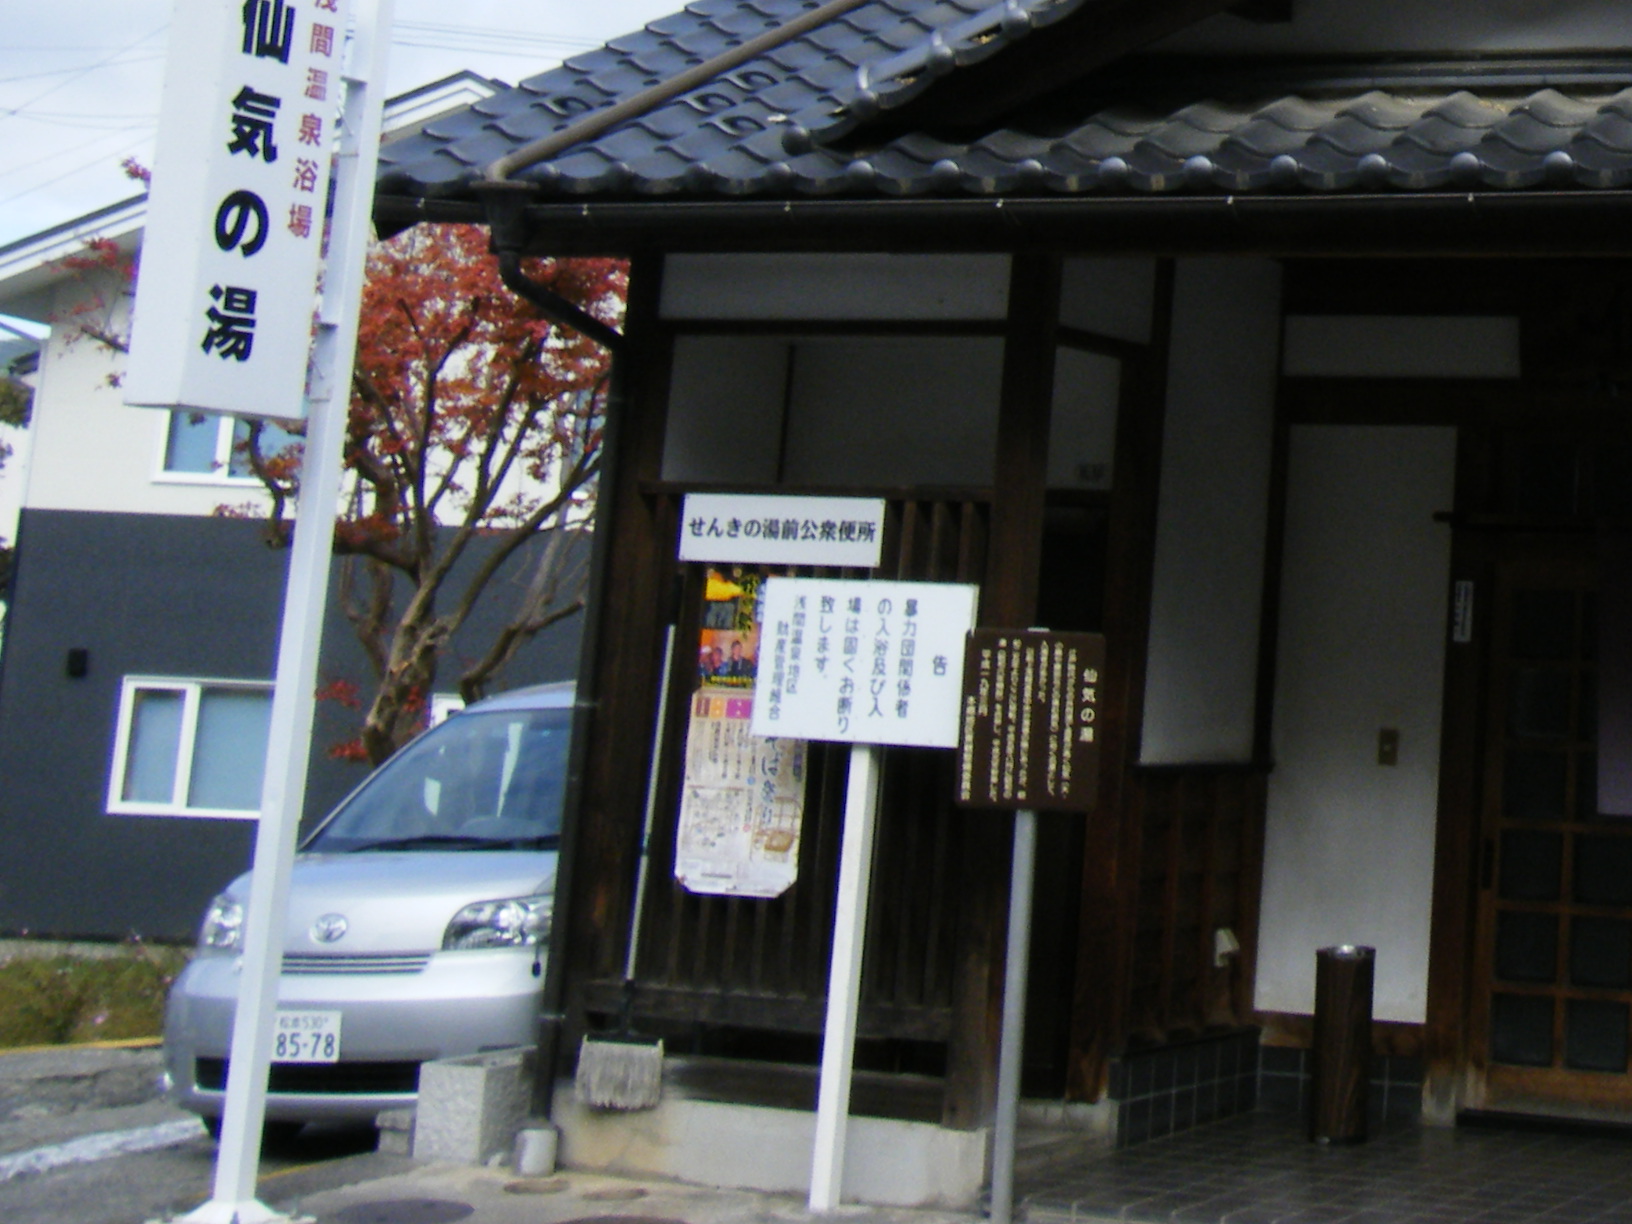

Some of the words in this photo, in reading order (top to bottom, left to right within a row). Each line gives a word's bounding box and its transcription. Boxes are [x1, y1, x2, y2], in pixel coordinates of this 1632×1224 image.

[688, 517, 877, 543] せんきの湯前公衆便所
[837, 596, 861, 734] 場は固くお断り
[868, 598, 892, 718] の入浴及び入
[895, 598, 918, 718] 暴力団関係者
[276, 1032, 335, 1058] 85-78
